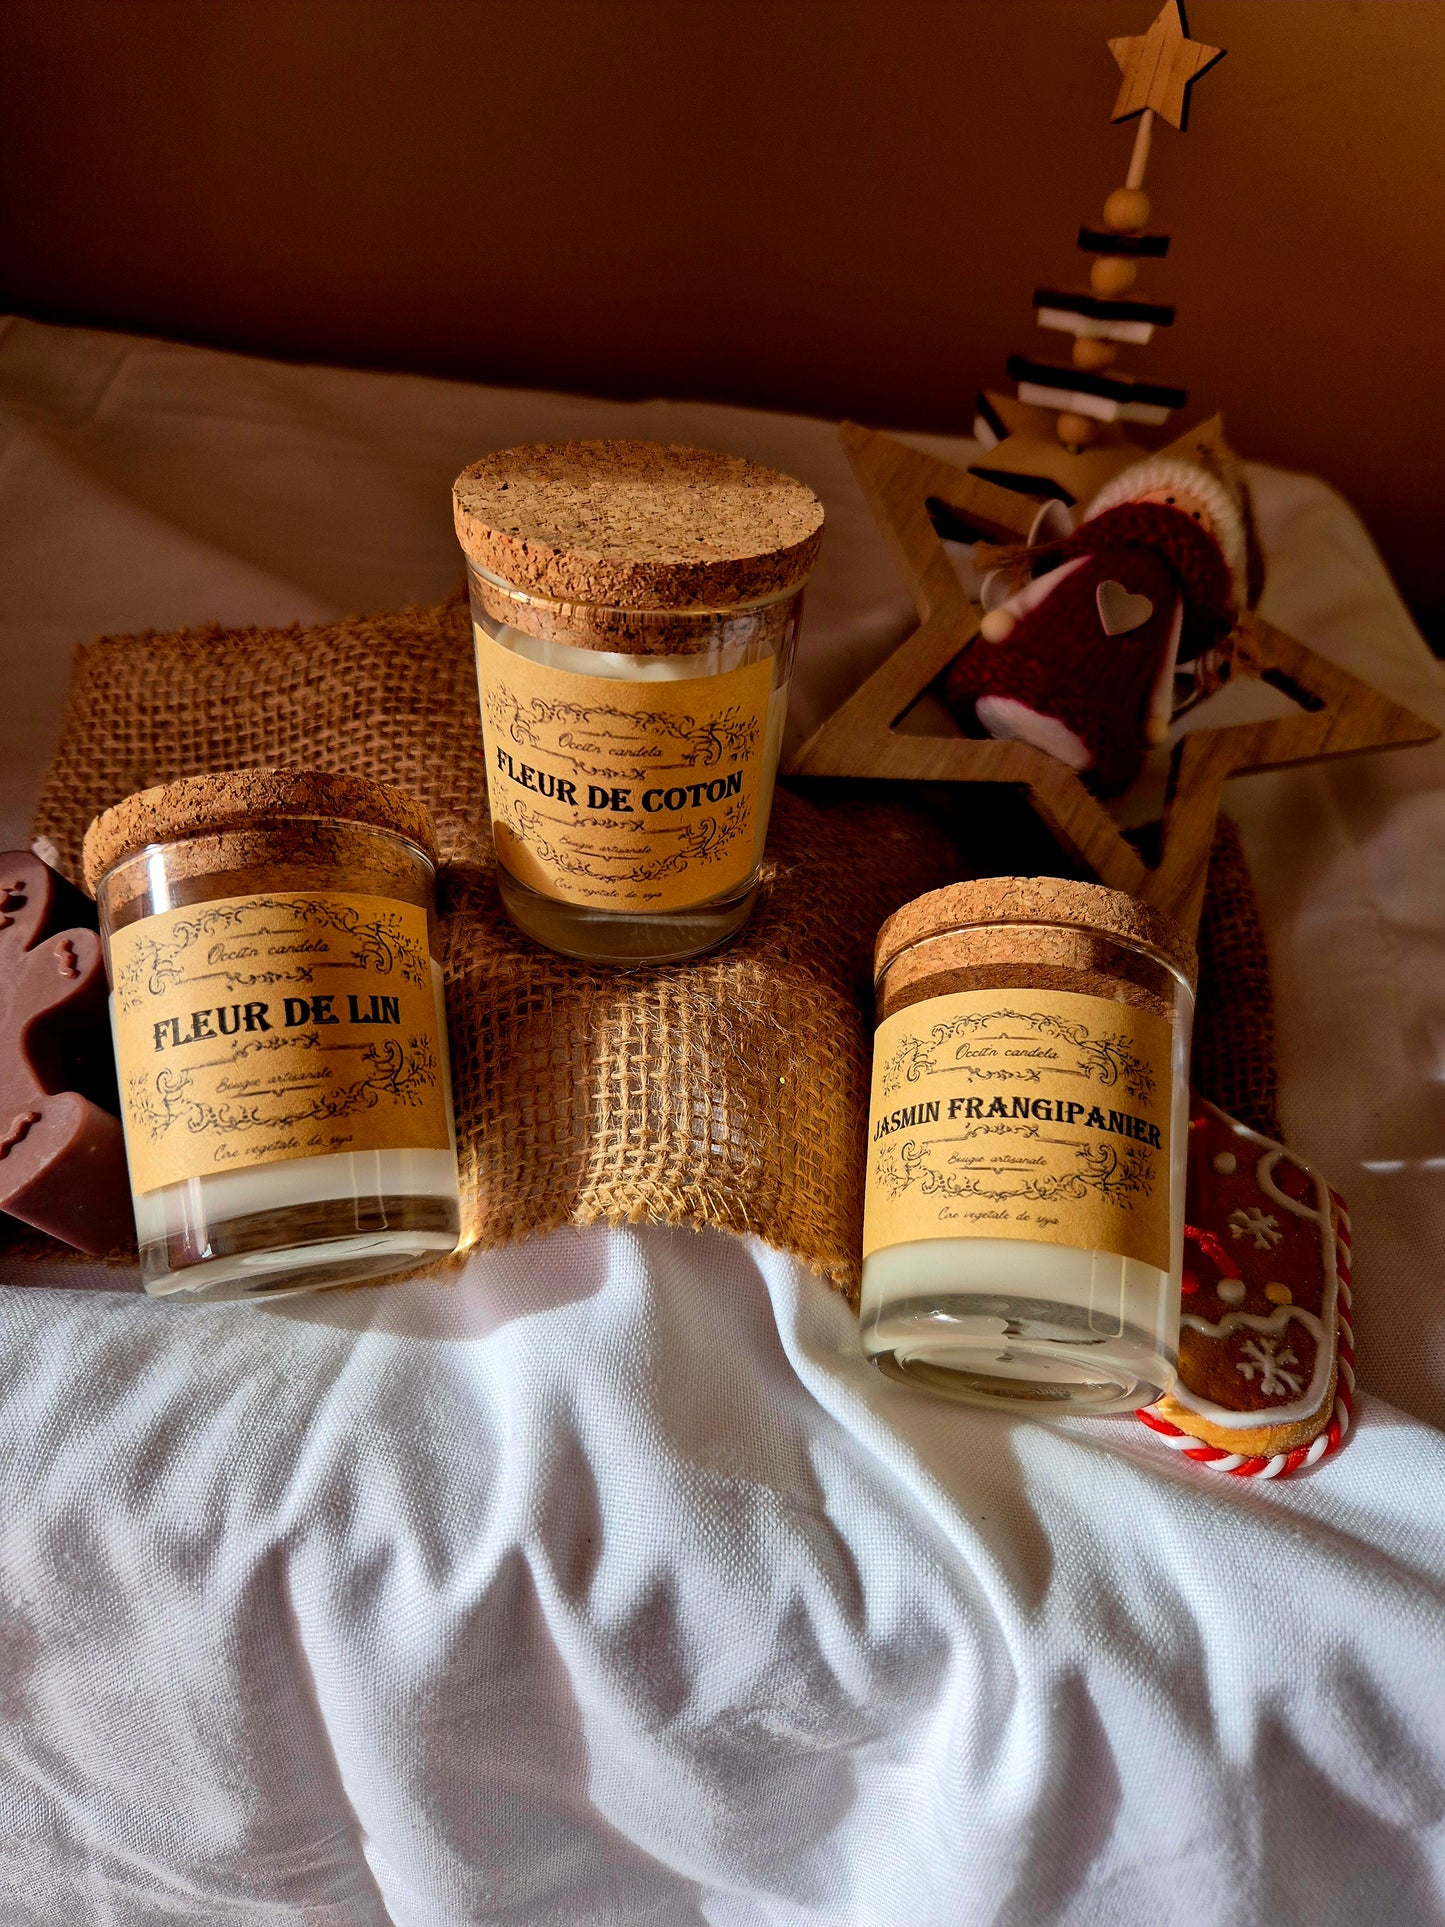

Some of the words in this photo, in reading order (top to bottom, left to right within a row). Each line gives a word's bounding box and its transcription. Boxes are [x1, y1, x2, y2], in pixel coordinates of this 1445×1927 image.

[496, 745, 579, 807] FLEUR
[586, 785, 634, 813] DE
[641, 770, 744, 813] COTON
[153, 1001, 274, 1052] FLEUR
[283, 995, 340, 1028] DE
[349, 994, 401, 1025] LIN
[1004, 1046, 1059, 1060] candela
[873, 1100, 940, 1142] JASMIN
[947, 1096, 1162, 1150] FRANGIPANIER
[1015, 1211, 1030, 1222] de
